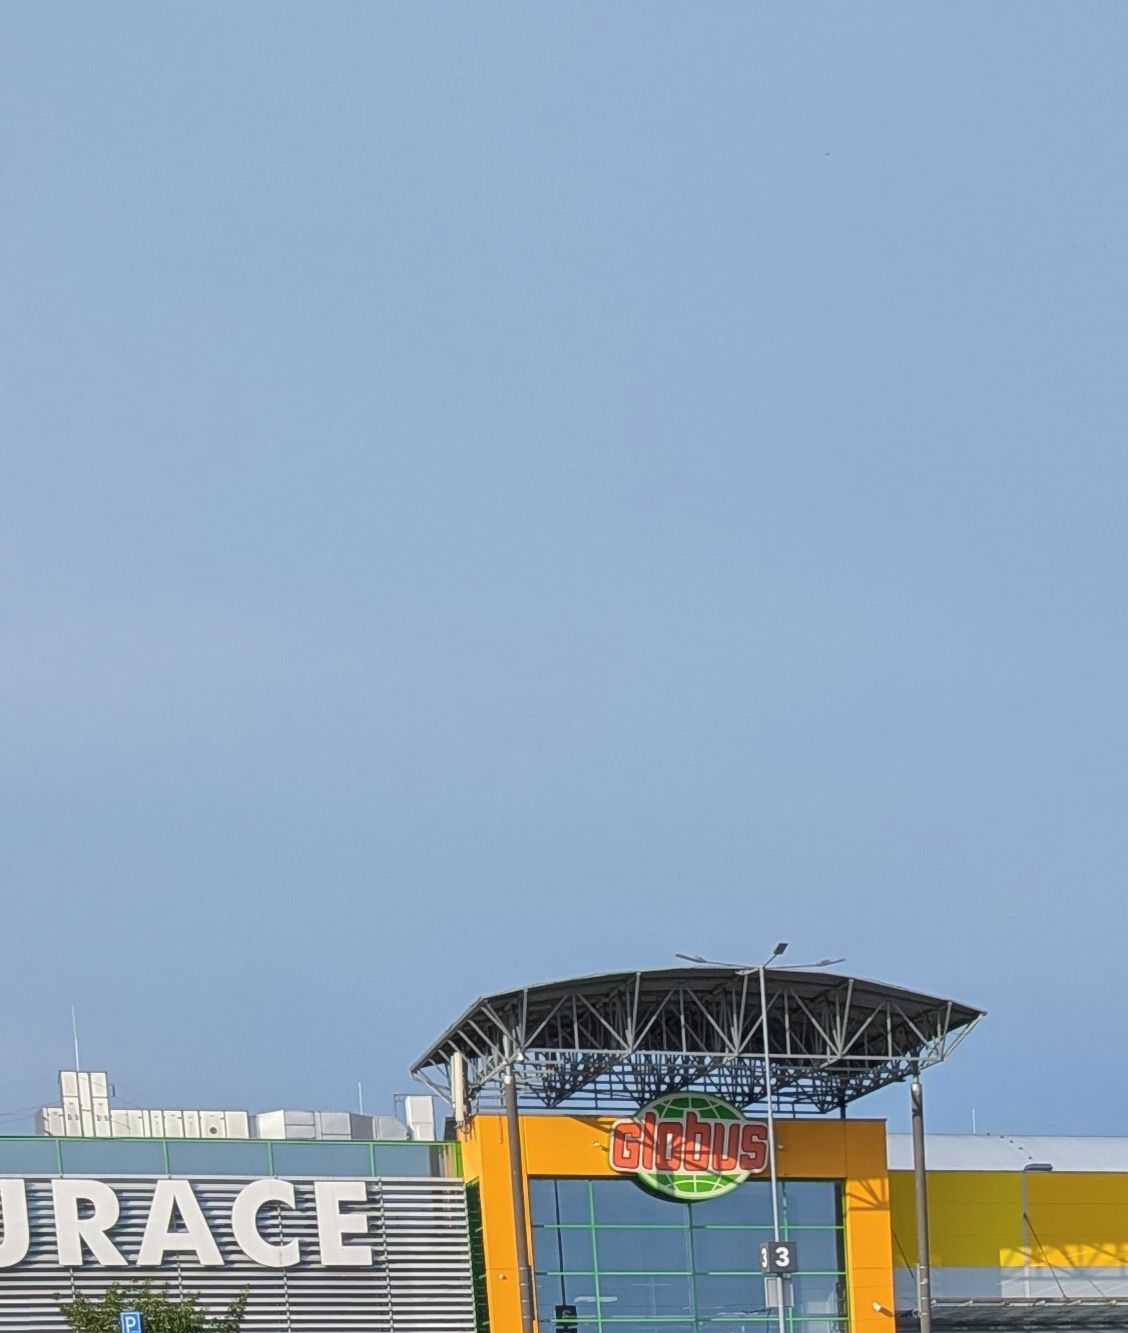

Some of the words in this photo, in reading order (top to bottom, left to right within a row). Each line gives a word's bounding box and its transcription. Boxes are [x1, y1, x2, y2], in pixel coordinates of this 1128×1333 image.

[761, 1247, 768, 1269] 3
[775, 1246, 790, 1267] 3
[124, 1316, 137, 1333] P
